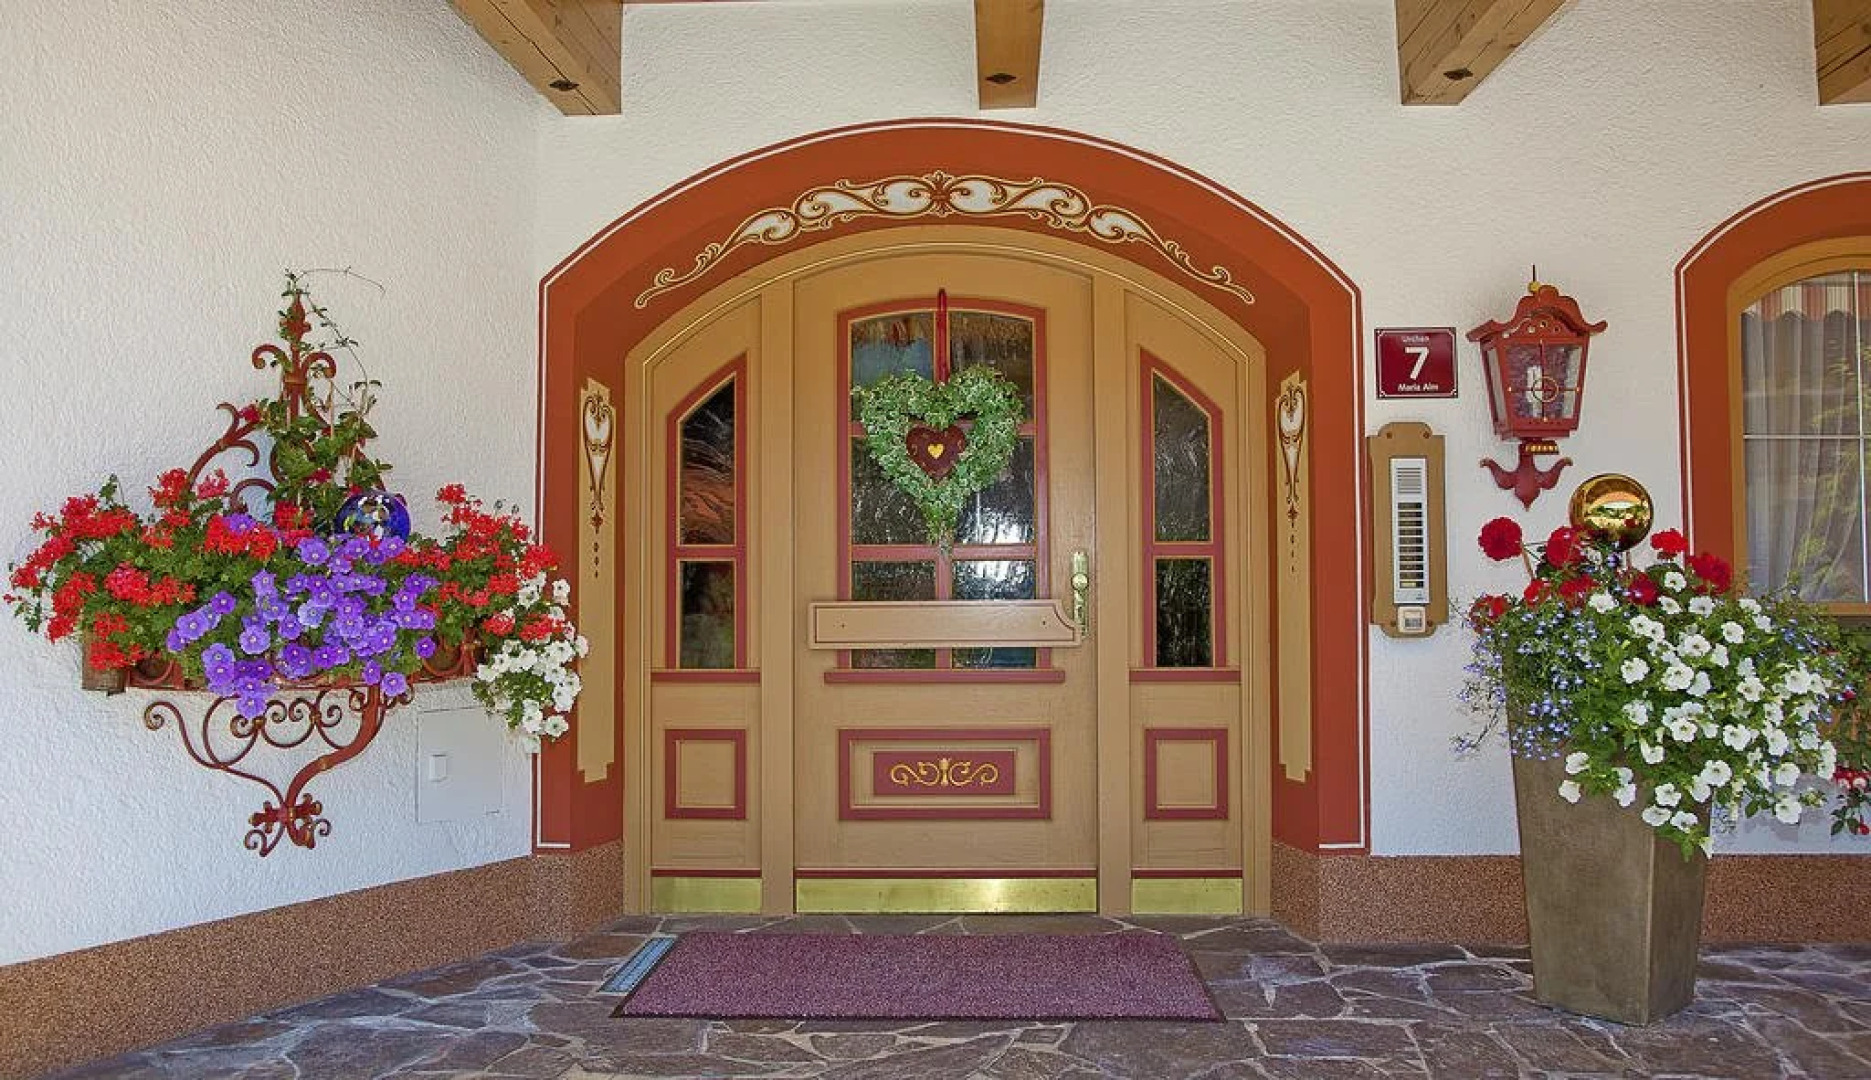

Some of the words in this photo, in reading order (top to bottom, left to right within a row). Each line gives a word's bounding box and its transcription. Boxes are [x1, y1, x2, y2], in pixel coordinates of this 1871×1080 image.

[1405, 346, 1430, 380] 7
[1397, 383, 1421, 392] Maria
[1423, 382, 1439, 391] Alm
